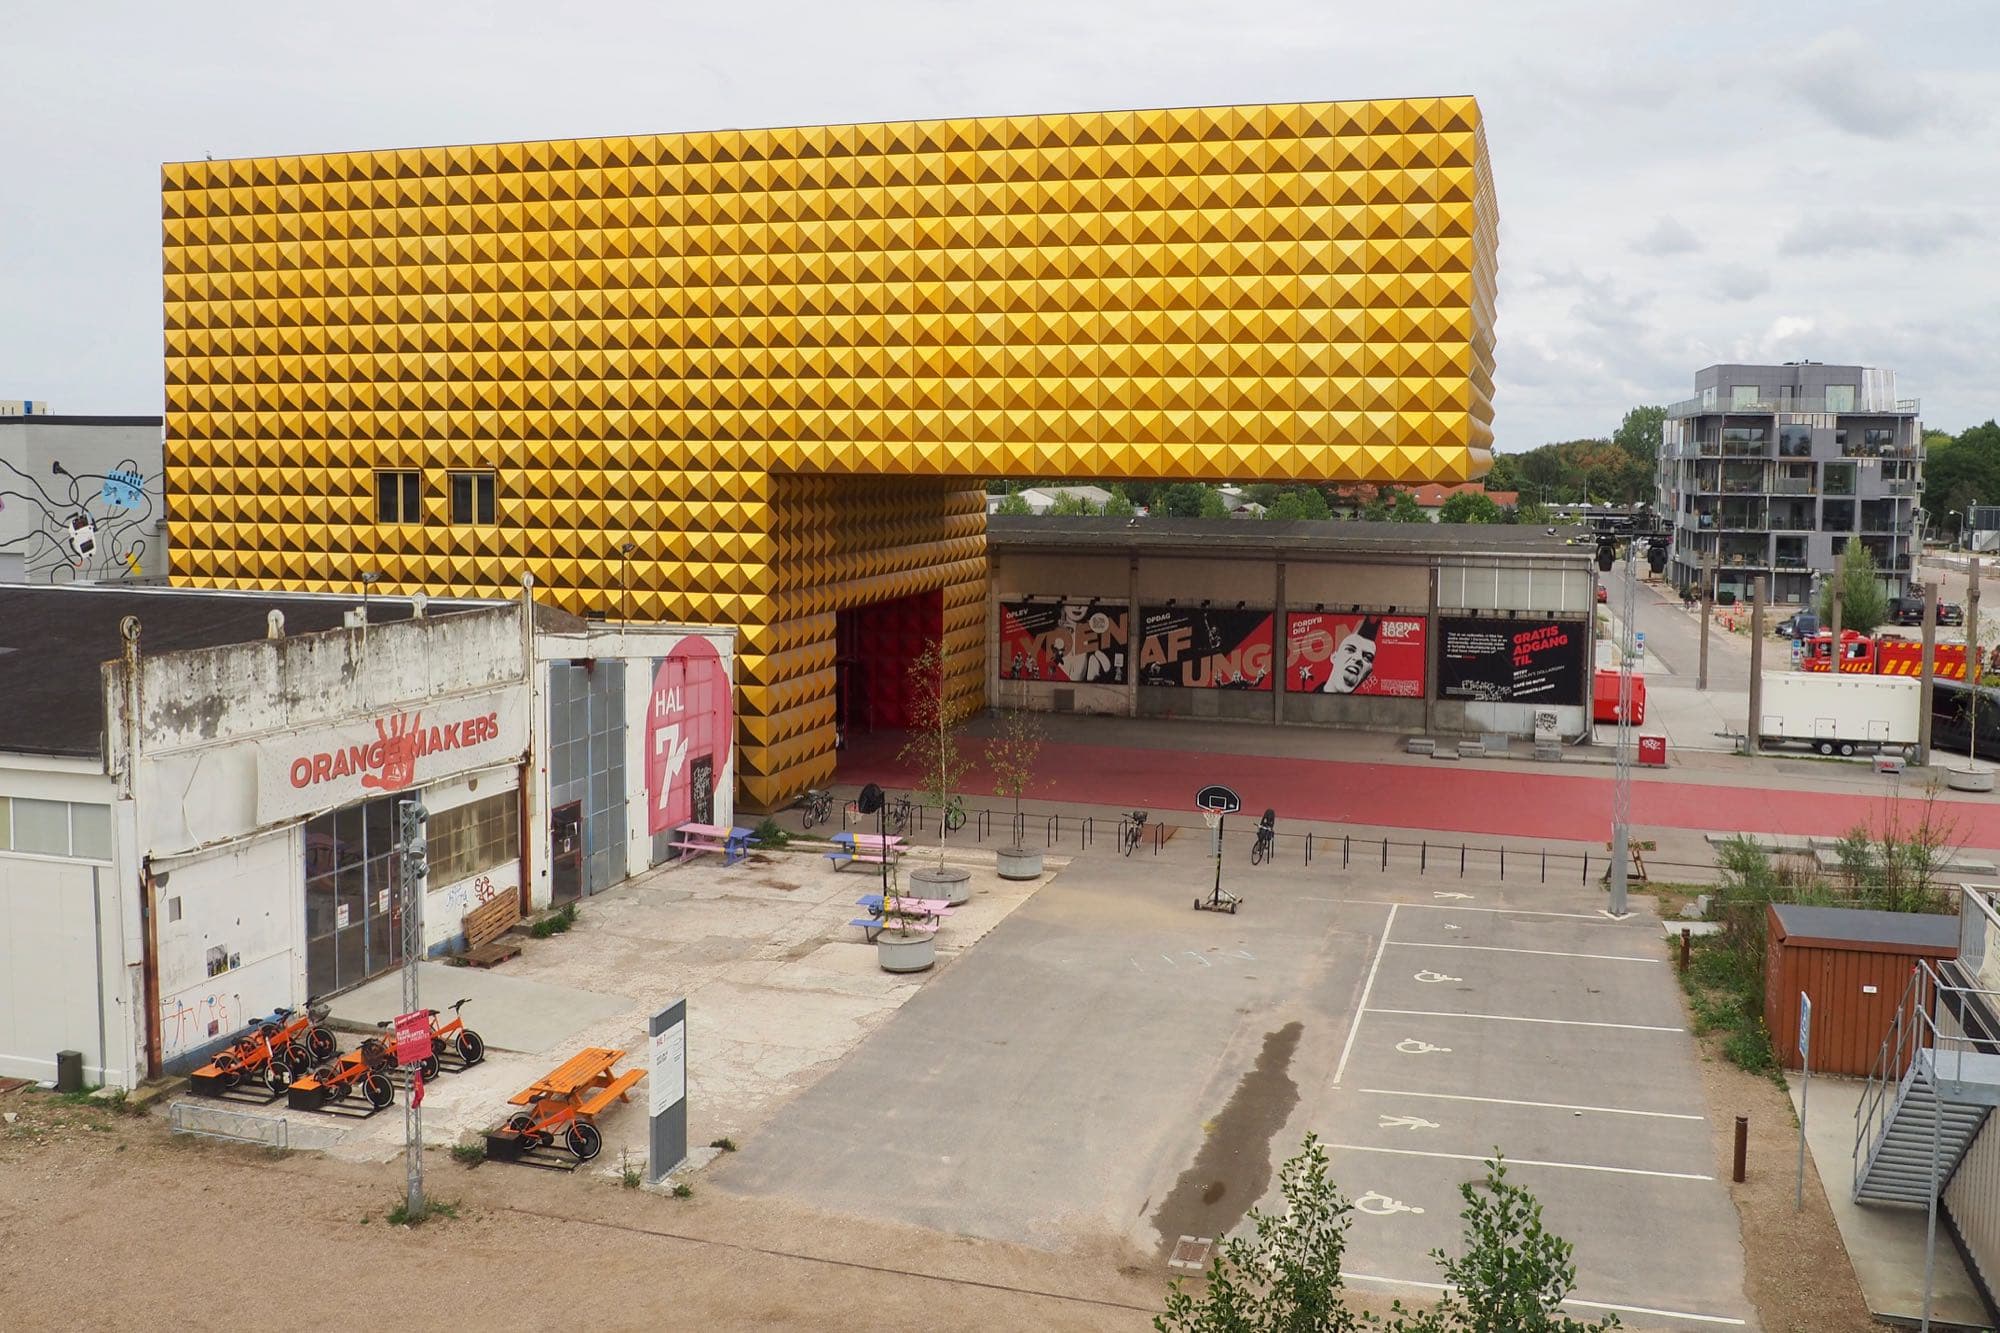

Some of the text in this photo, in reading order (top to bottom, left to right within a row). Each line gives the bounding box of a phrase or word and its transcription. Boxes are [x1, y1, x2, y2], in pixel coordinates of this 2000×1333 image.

[1146, 612, 1171, 624] OPDAG
[1293, 627, 1306, 635] DIG
[1513, 626, 1558, 644] GRATIS
[1140, 626, 1193, 669] AF
[1513, 635, 1568, 655] ADGANG
[1182, 643, 1272, 688] UNG
[1513, 655, 1532, 666] TIL
[656, 686, 685, 717] HAL
[290, 712, 499, 788] ORANGE MAKERS
[656, 723, 688, 810] 7
